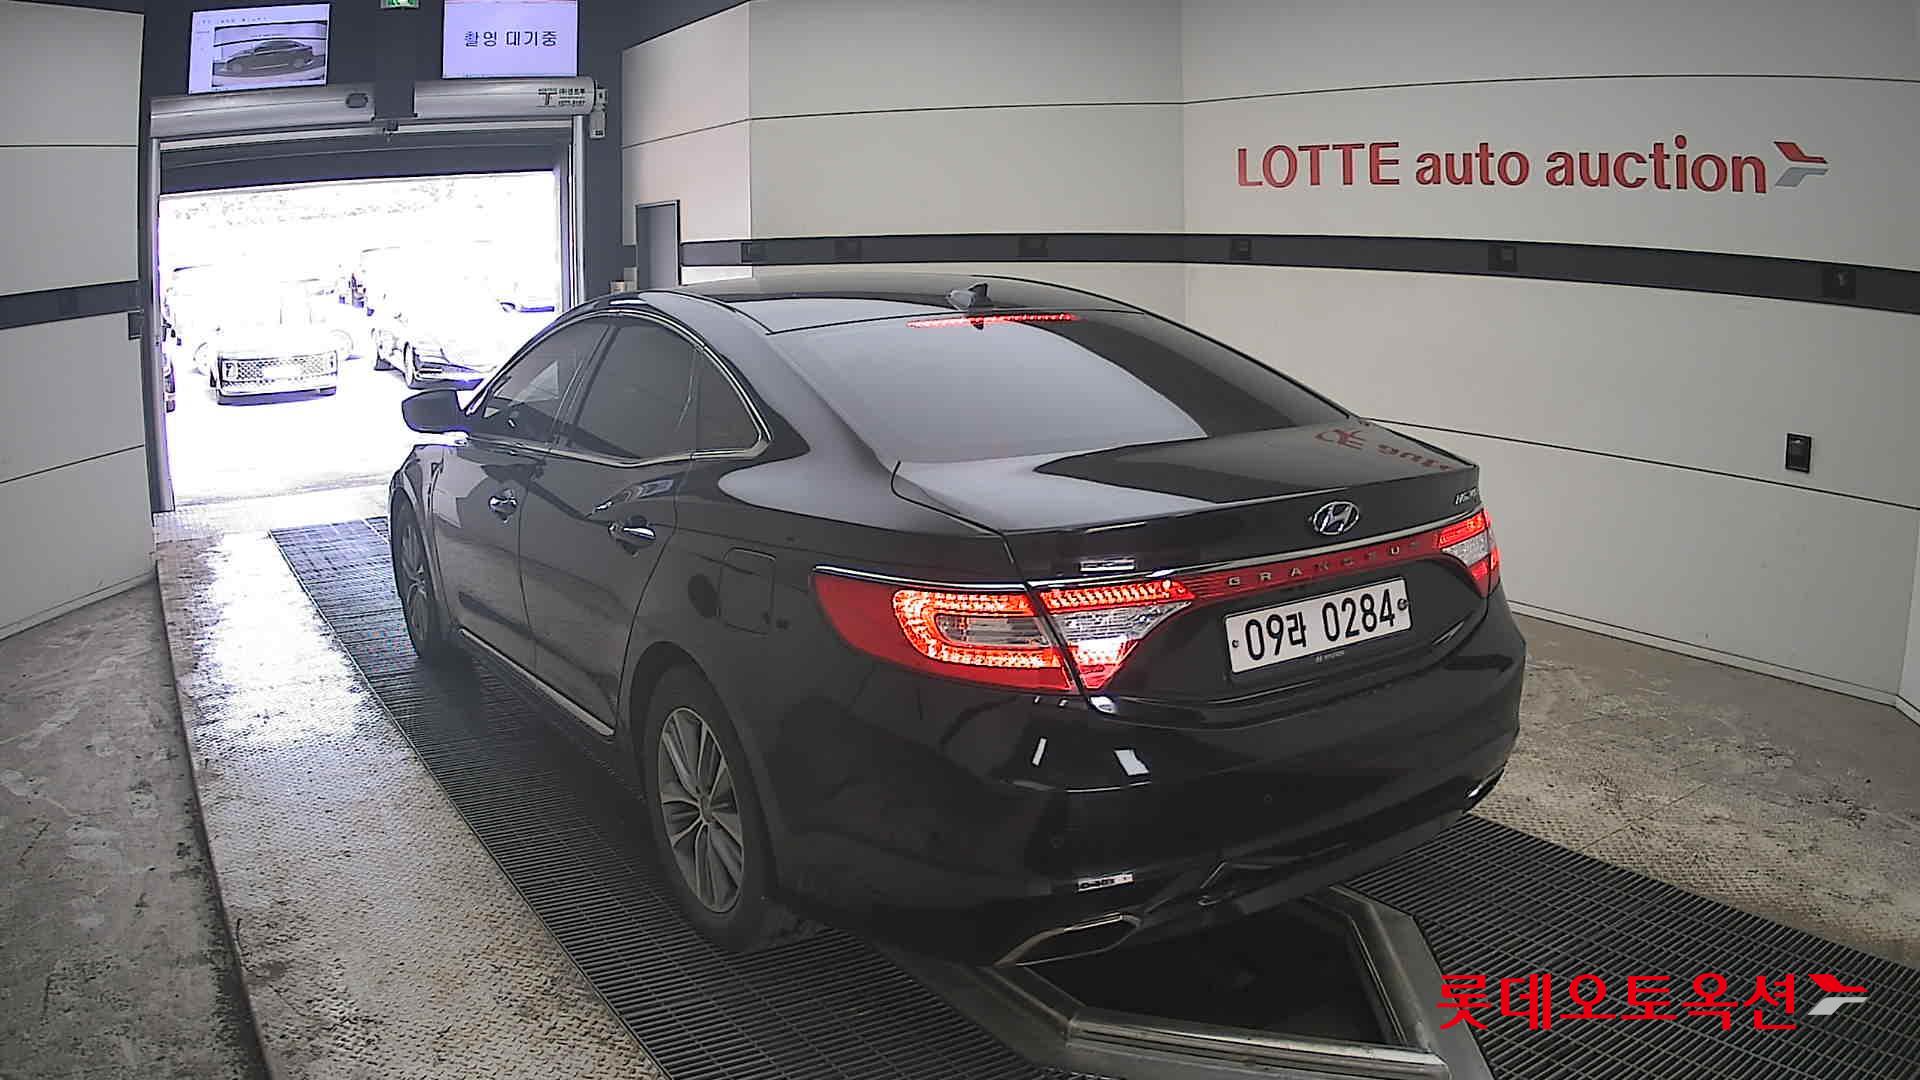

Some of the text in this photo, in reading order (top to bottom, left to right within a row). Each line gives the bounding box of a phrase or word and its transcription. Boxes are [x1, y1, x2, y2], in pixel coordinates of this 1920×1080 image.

[506, 31, 558, 48] 대기중
[1237, 134, 1767, 194] LOTTE auto auction
[1245, 588, 1396, 661] 09라 0284
